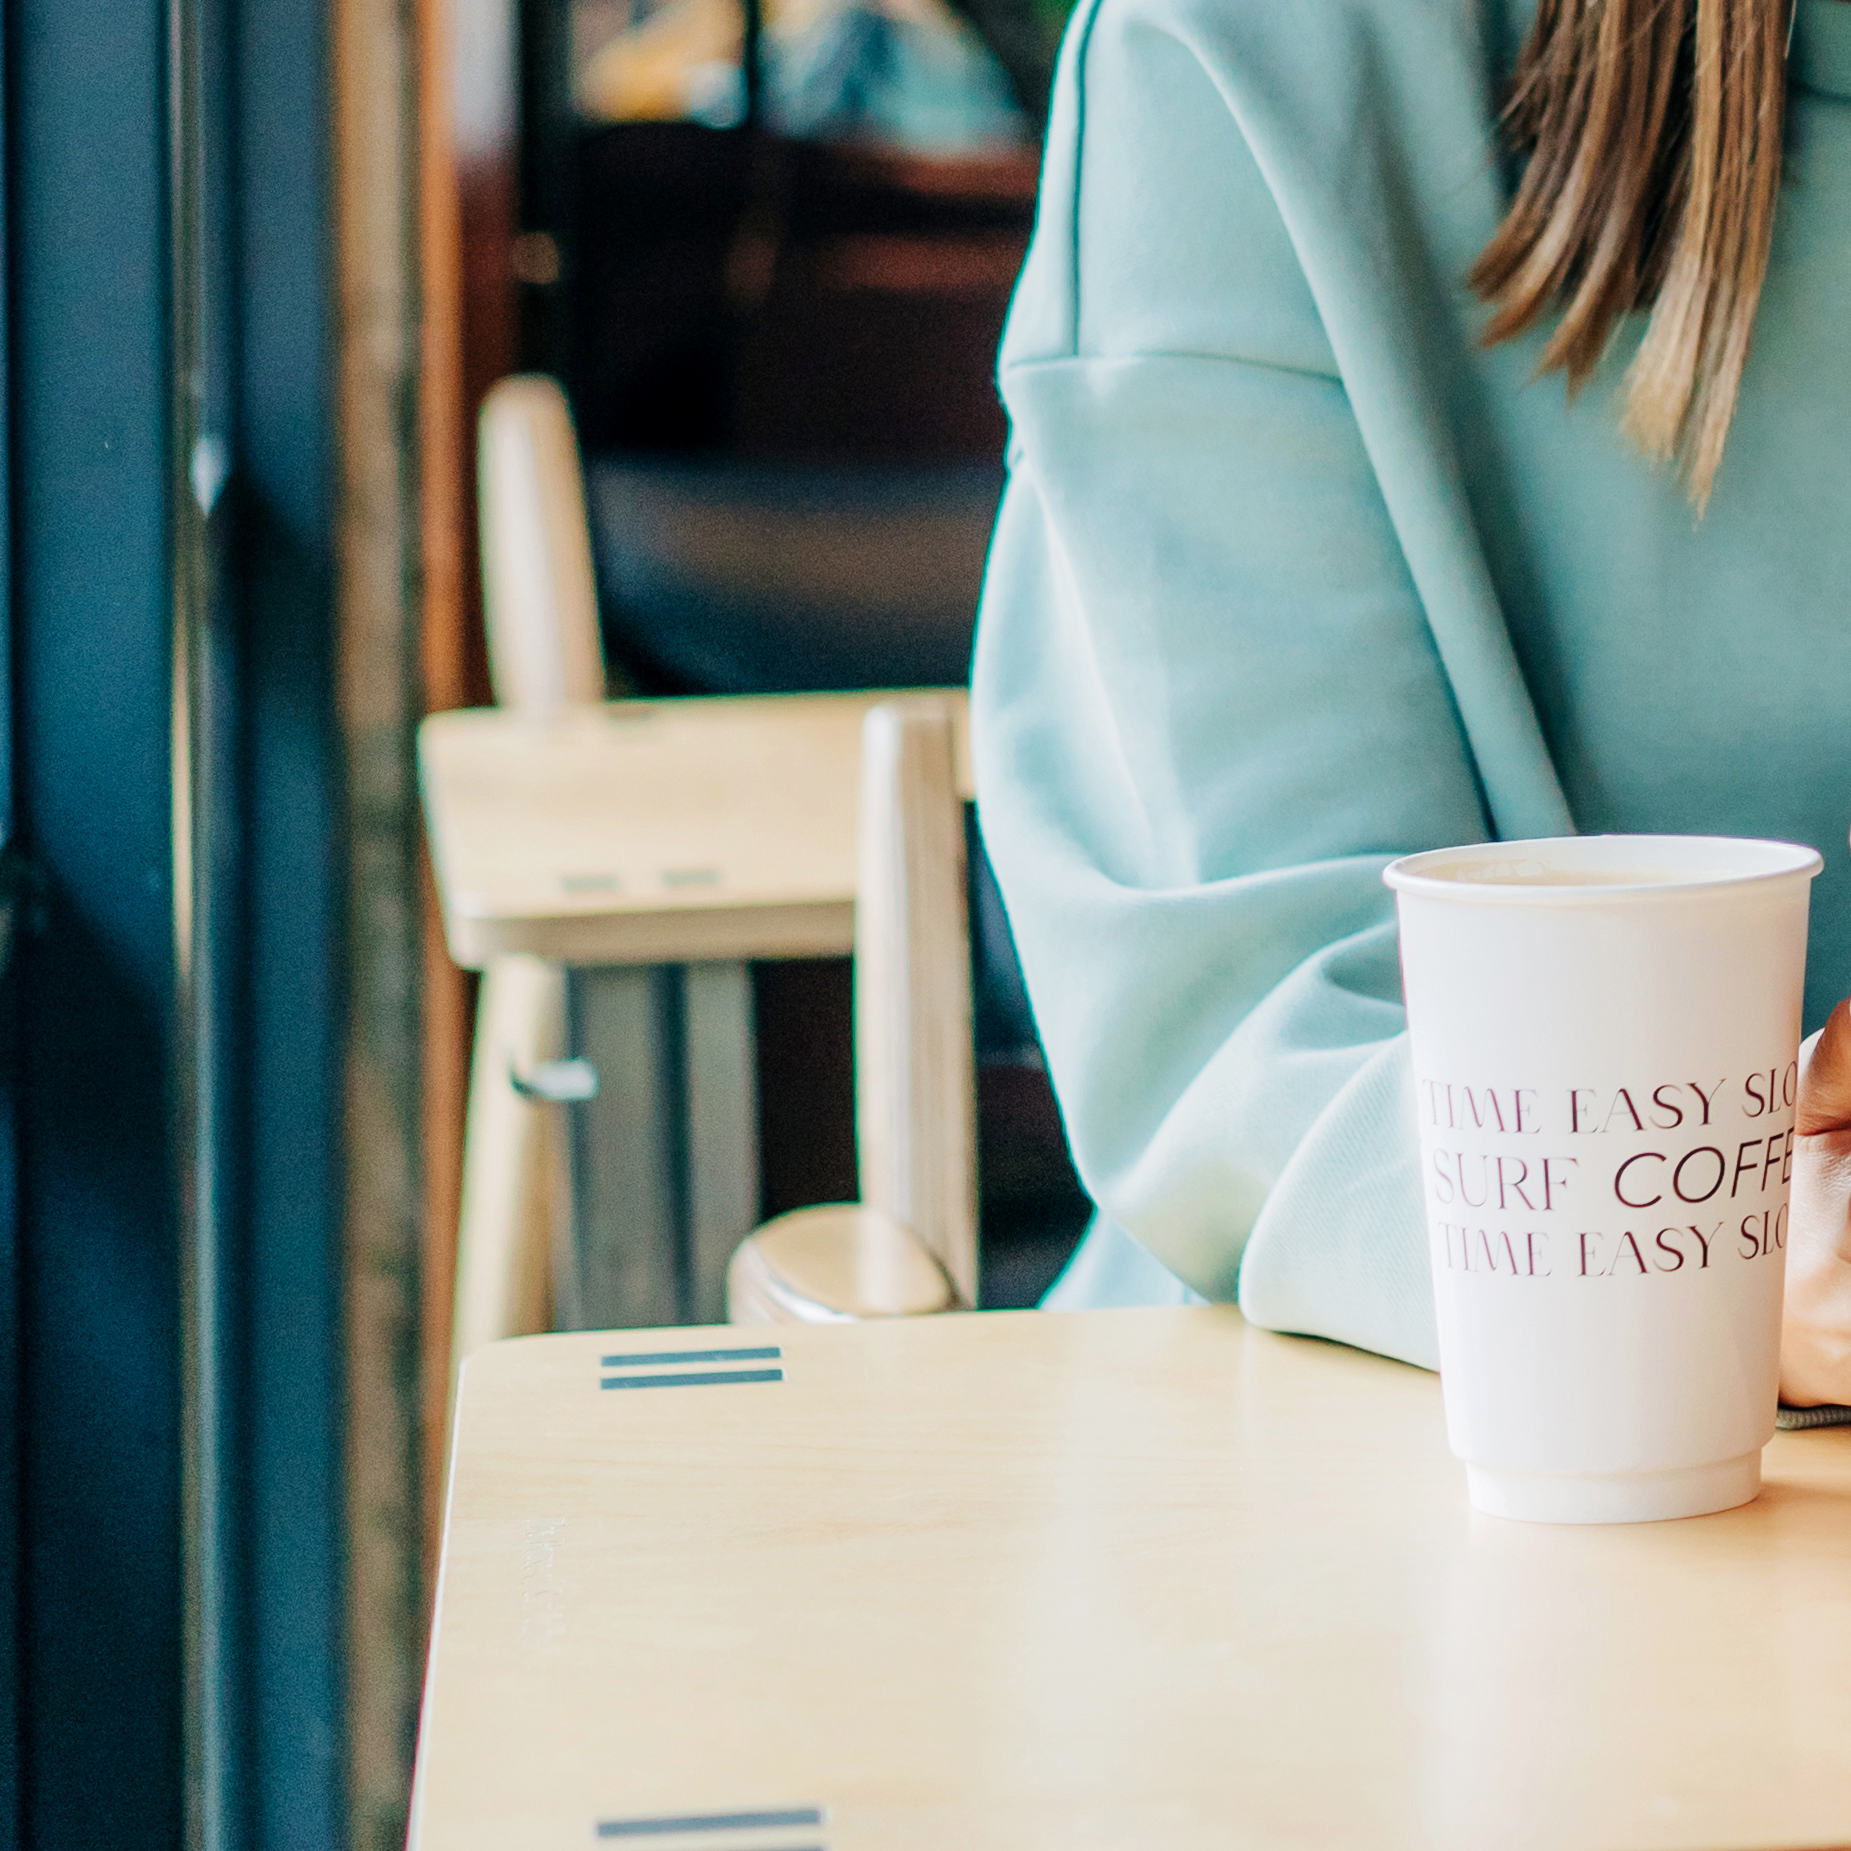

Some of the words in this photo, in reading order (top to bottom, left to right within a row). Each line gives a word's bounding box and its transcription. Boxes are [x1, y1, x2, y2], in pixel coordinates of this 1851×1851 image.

[1422, 1079, 1542, 1134] TIME
[1566, 1078, 1726, 1134] EASY
[1433, 1148, 1579, 1211] SURF
[1438, 1221, 1552, 1277] TIME
[1577, 1221, 1725, 1277] EASY
